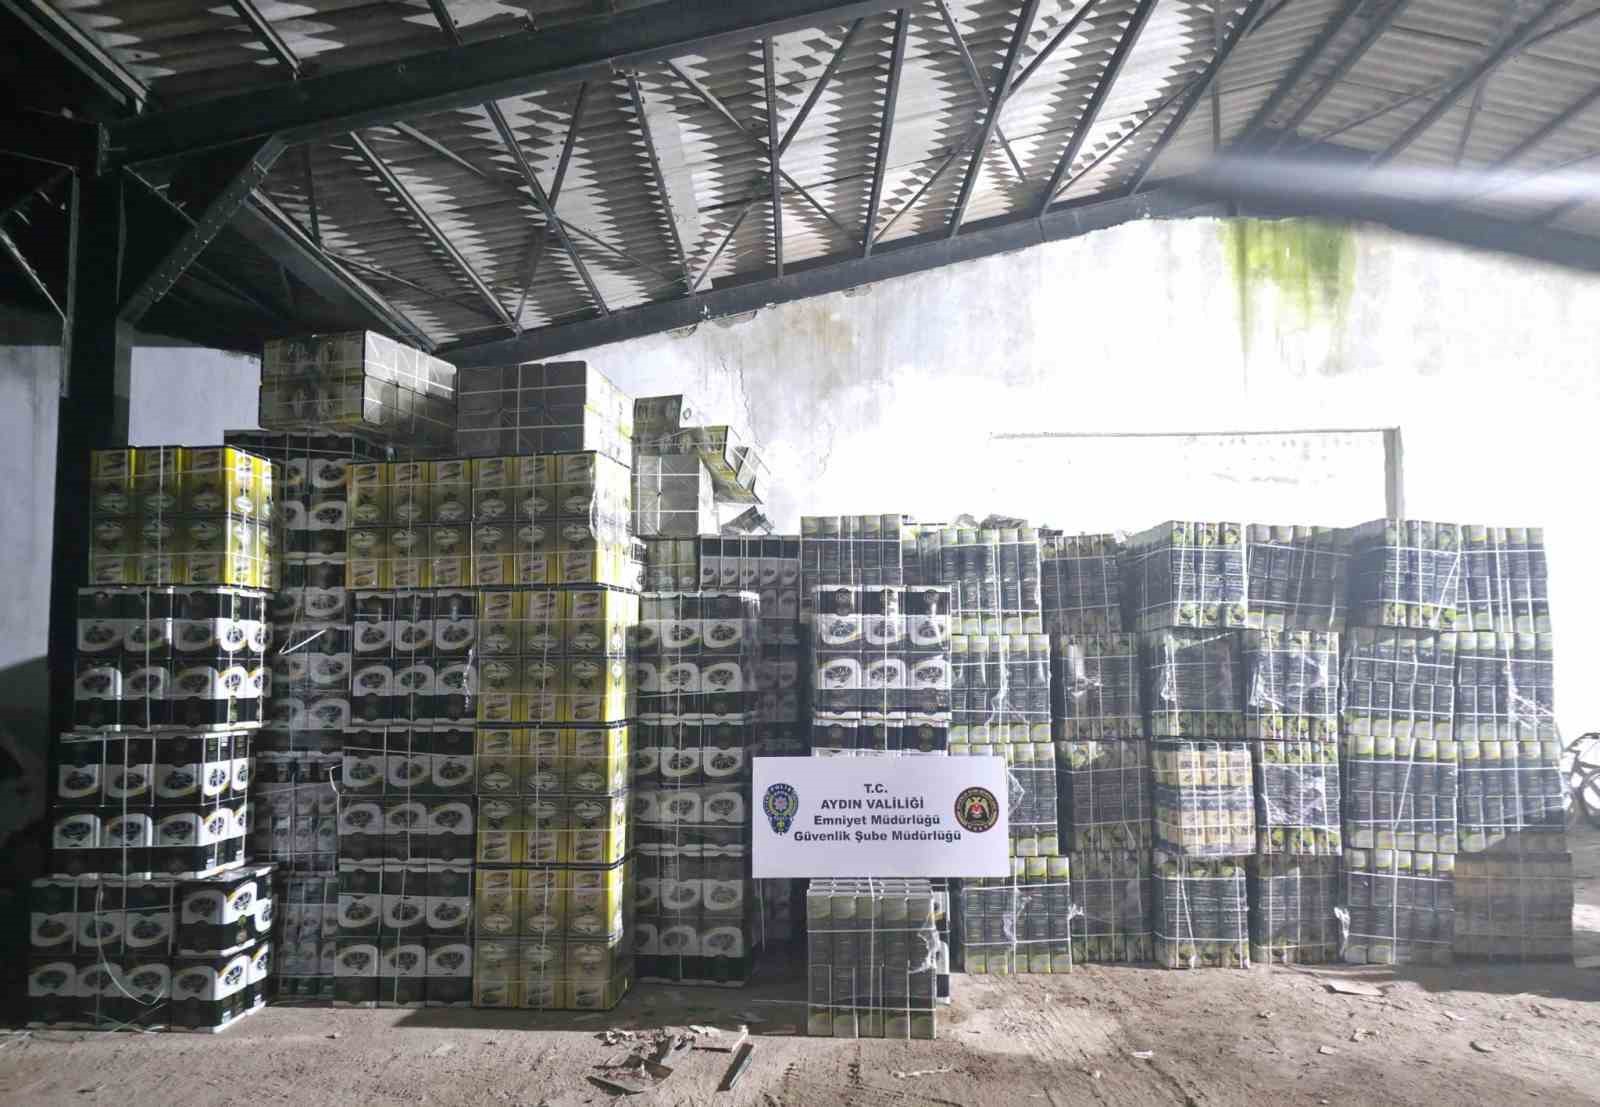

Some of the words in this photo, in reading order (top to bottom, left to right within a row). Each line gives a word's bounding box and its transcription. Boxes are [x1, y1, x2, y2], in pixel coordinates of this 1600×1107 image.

[864, 784, 888, 794] T.C.
[821, 799, 862, 810] AYDIN
[866, 796, 924, 810] VALİLİĞİ
[814, 815, 867, 828] Emniyet
[871, 815, 941, 828] Müdürlüğü
[794, 831, 850, 842] Güvenlik
[855, 831, 887, 843] Şube
[892, 830, 962, 843] Müdürlüğü
